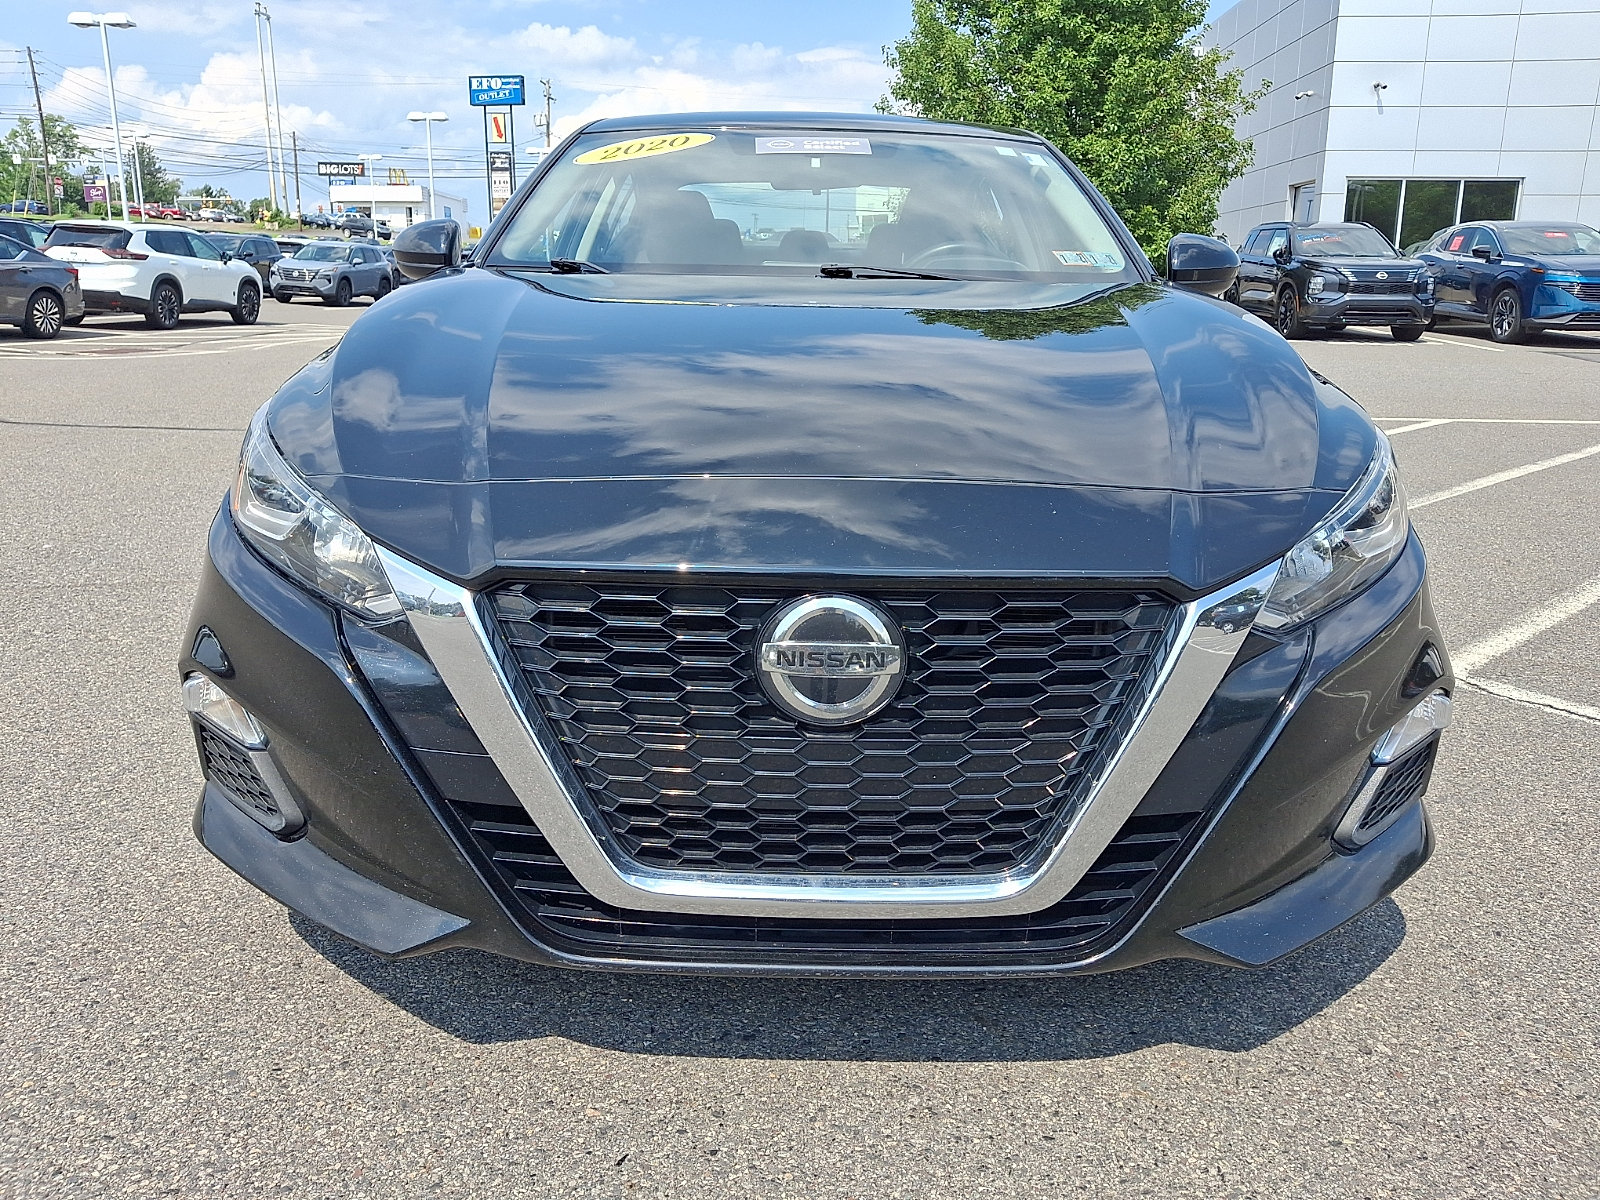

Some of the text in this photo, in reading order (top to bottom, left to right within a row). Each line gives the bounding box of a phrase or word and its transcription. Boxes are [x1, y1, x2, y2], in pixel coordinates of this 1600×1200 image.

[471, 77, 502, 90] EFO
[478, 89, 510, 101] OUTLET
[600, 136, 690, 160] 2020
[777, 650, 885, 668] NISSAN
